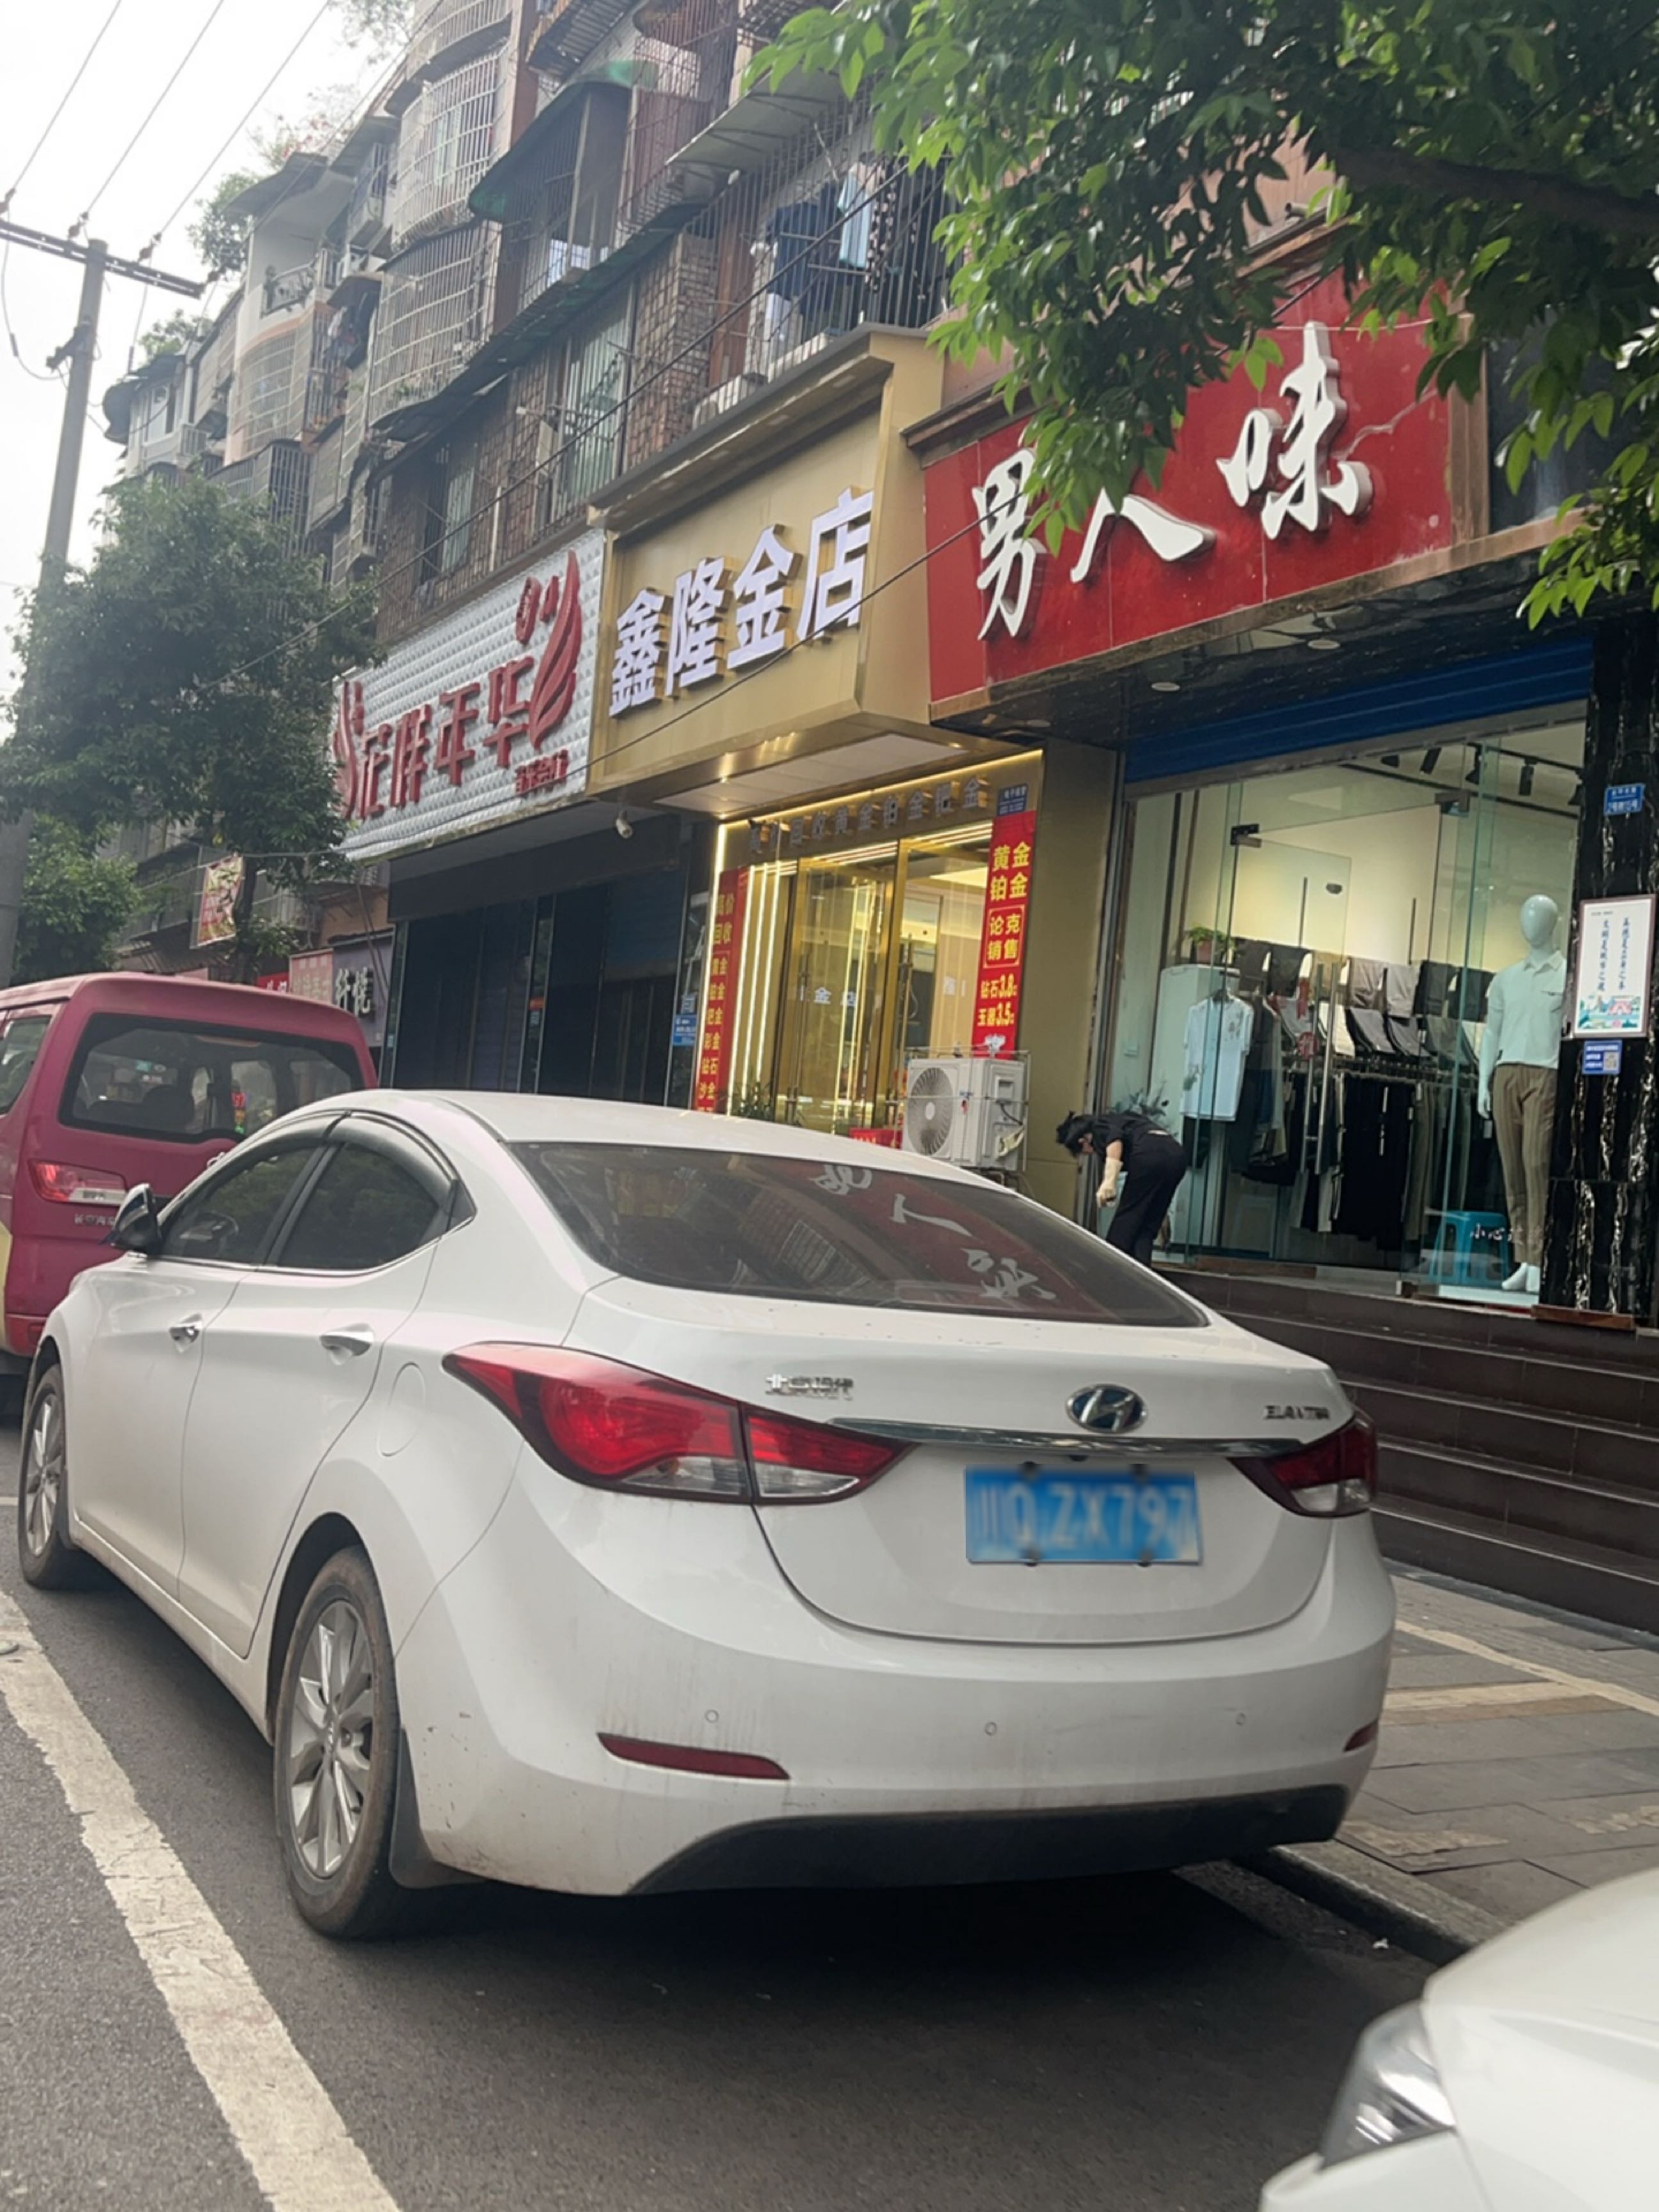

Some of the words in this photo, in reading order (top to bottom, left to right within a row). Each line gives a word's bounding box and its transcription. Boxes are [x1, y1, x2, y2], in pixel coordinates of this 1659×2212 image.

[972, 321, 1374, 640] 男人味
[609, 488, 873, 718] 鑫隆金店
[993, 841, 1031, 871] 黄金
[990, 872, 1028, 901] 铂金
[990, 913, 1021, 936] 论克
[987, 938, 1019, 961] 销售
